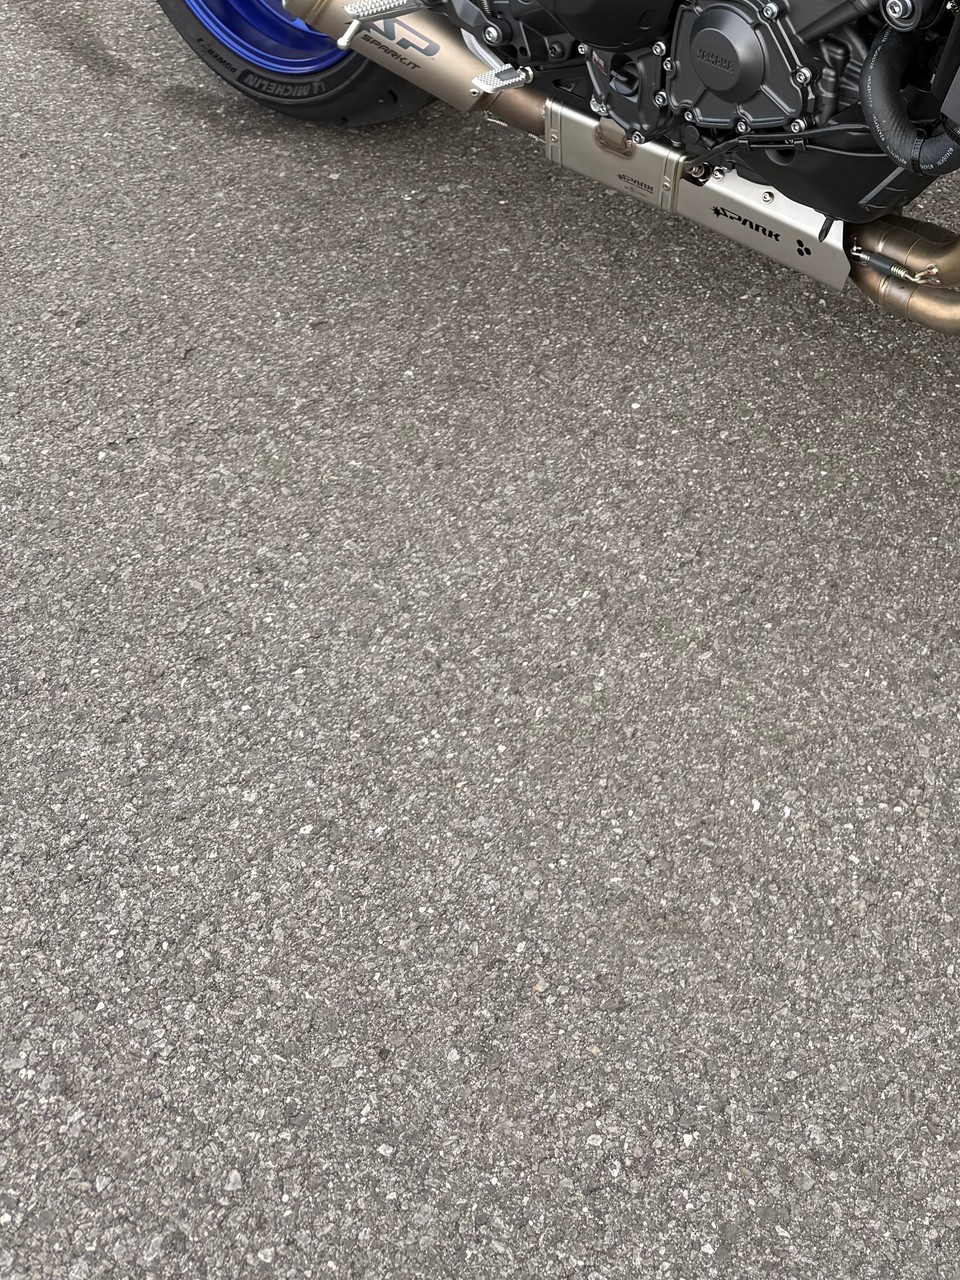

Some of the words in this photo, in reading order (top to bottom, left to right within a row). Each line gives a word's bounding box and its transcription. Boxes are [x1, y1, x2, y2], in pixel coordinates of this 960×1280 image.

[696, 48, 734, 74] YAMAHA
[244, 73, 311, 97] MICHELIN
[717, 206, 781, 243] SPARK
